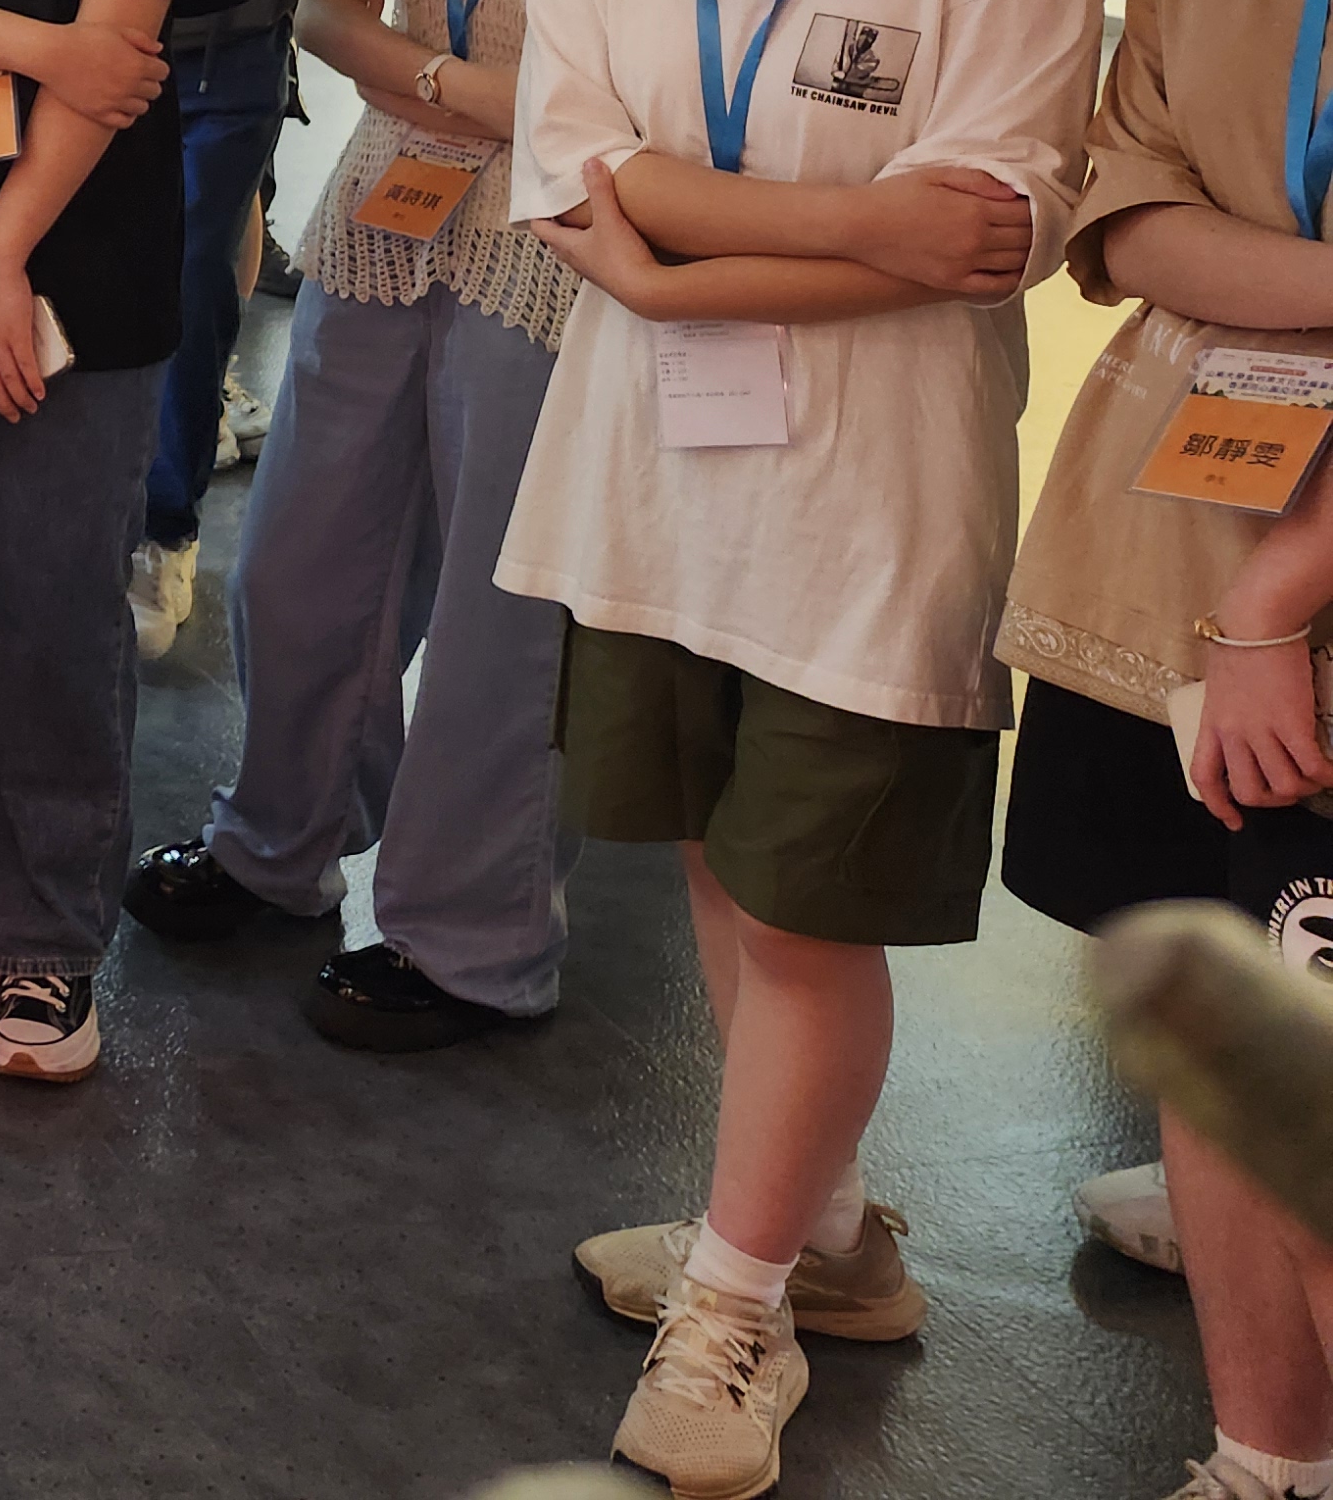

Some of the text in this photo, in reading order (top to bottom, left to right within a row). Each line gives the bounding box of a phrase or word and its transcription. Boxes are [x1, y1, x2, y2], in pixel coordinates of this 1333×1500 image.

[790, 85, 899, 117] THE CHAINSAW DEVIL
[1179, 432, 1286, 469] 鄒靜雯
